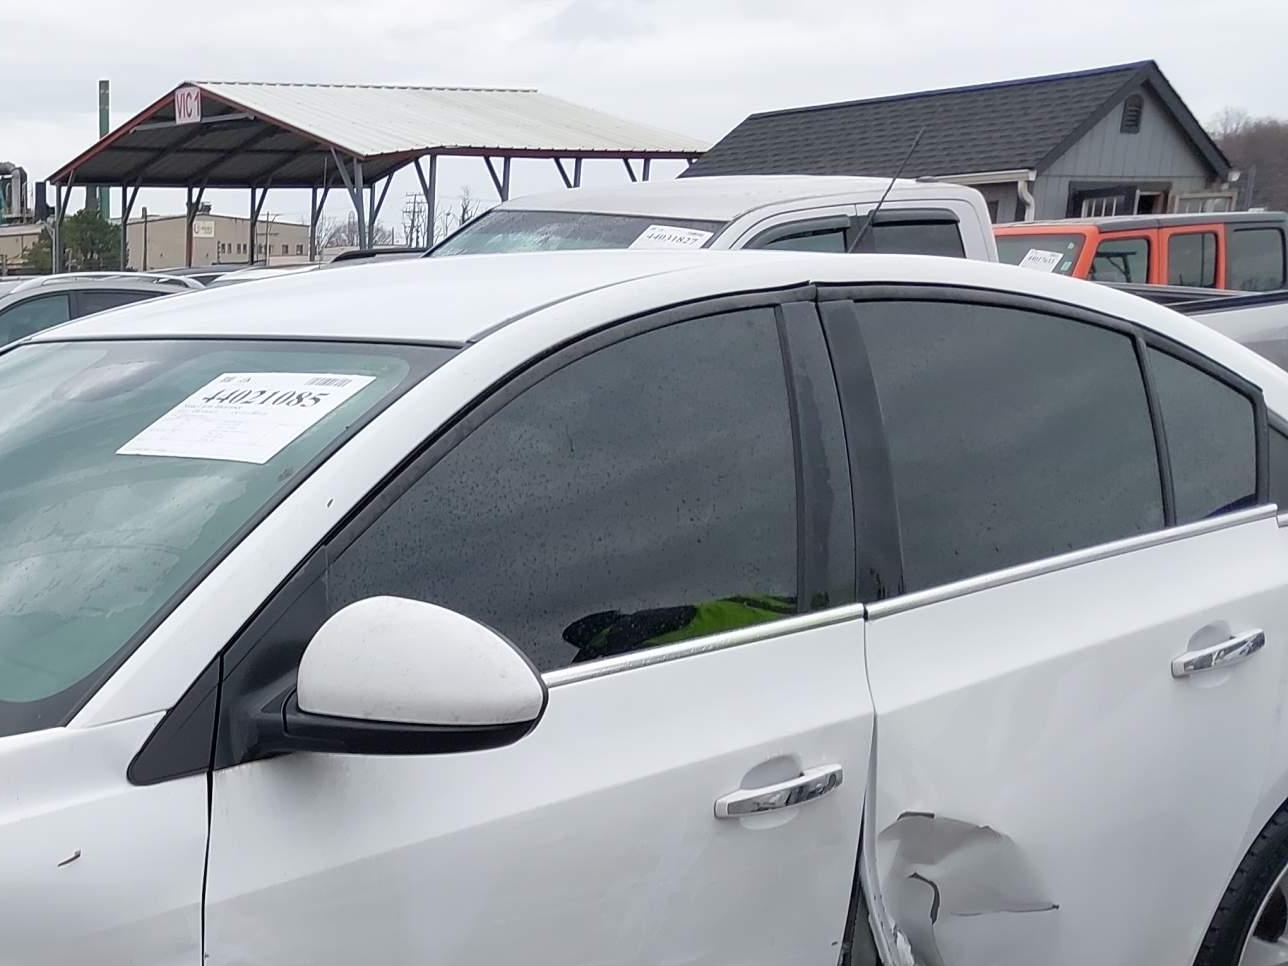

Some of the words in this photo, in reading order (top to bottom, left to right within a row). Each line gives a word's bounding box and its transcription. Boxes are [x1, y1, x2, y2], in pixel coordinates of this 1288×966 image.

[177, 92, 192, 119] VIC
[194, 91, 200, 117] 1
[203, 389, 329, 408] 44021085
